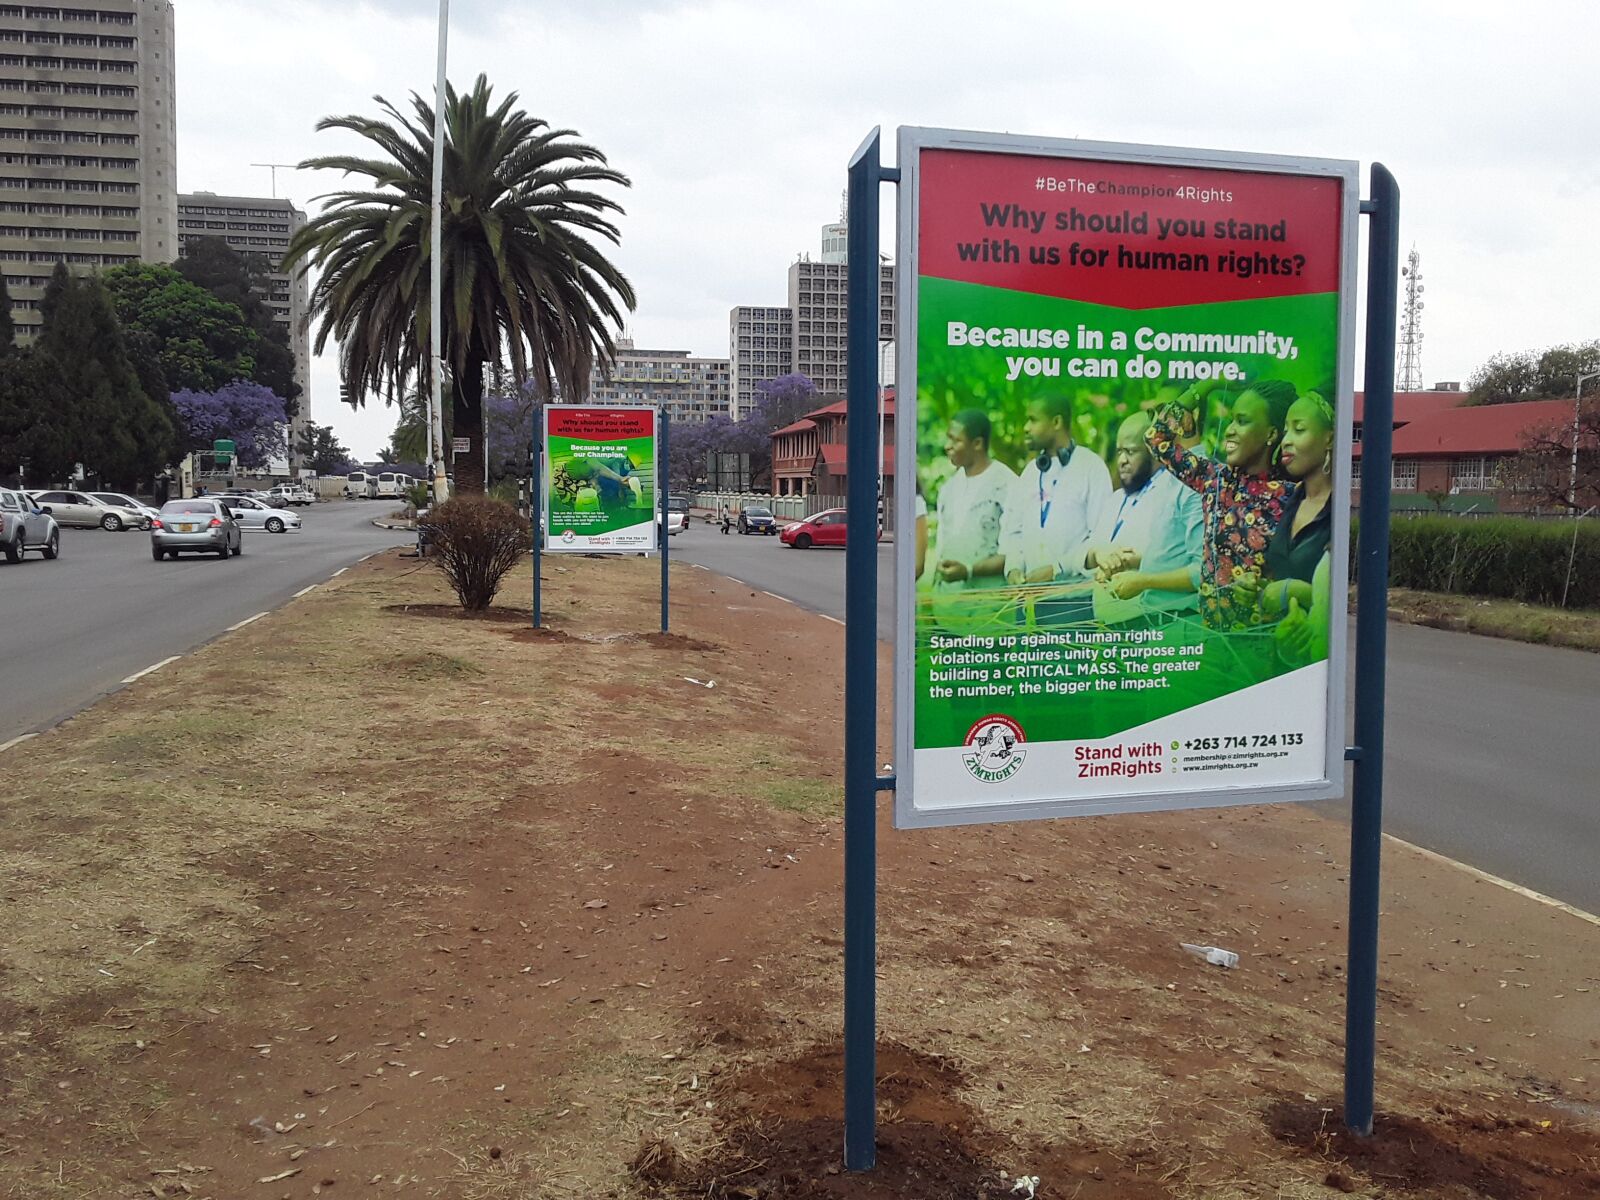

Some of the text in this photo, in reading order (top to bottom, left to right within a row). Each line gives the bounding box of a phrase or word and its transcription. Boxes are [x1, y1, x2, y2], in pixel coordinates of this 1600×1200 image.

[979, 202, 1287, 242] Why should you stand
[956, 237, 1307, 279] with us for human rights?
[946, 321, 1299, 359] Because in a Community,
[1004, 353, 1247, 381] you can do more.
[929, 629, 1164, 650] Standing up against human rights
[929, 643, 1204, 666] violations requires unity of purpose and
[928, 659, 1201, 683] building a CRITICAL MASS. The greater
[928, 675, 1171, 699] the number, the bigger the impact.
[1074, 742, 1162, 761] Stand with
[1184, 732, 1304, 751] +263 714 724 133
[966, 755, 1023, 781] ZIMRIGHTS
[1077, 759, 1163, 779] ZimRights
